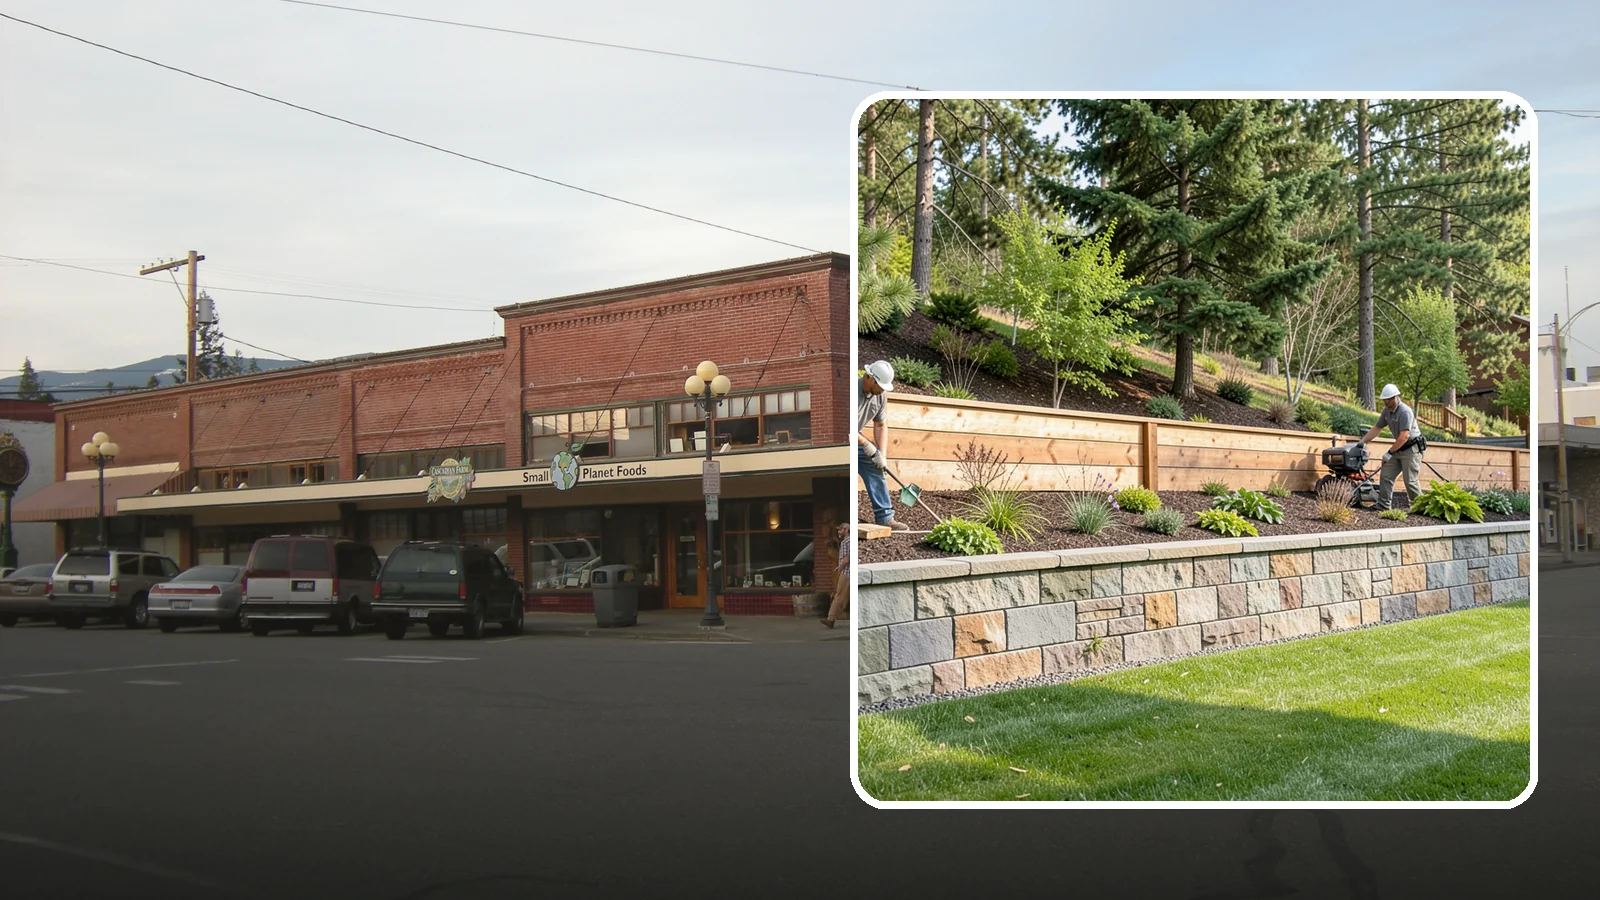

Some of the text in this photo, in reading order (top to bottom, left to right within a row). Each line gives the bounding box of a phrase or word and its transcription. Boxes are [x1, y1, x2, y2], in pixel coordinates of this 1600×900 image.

[523, 464, 647, 483] Small Planet Foods
